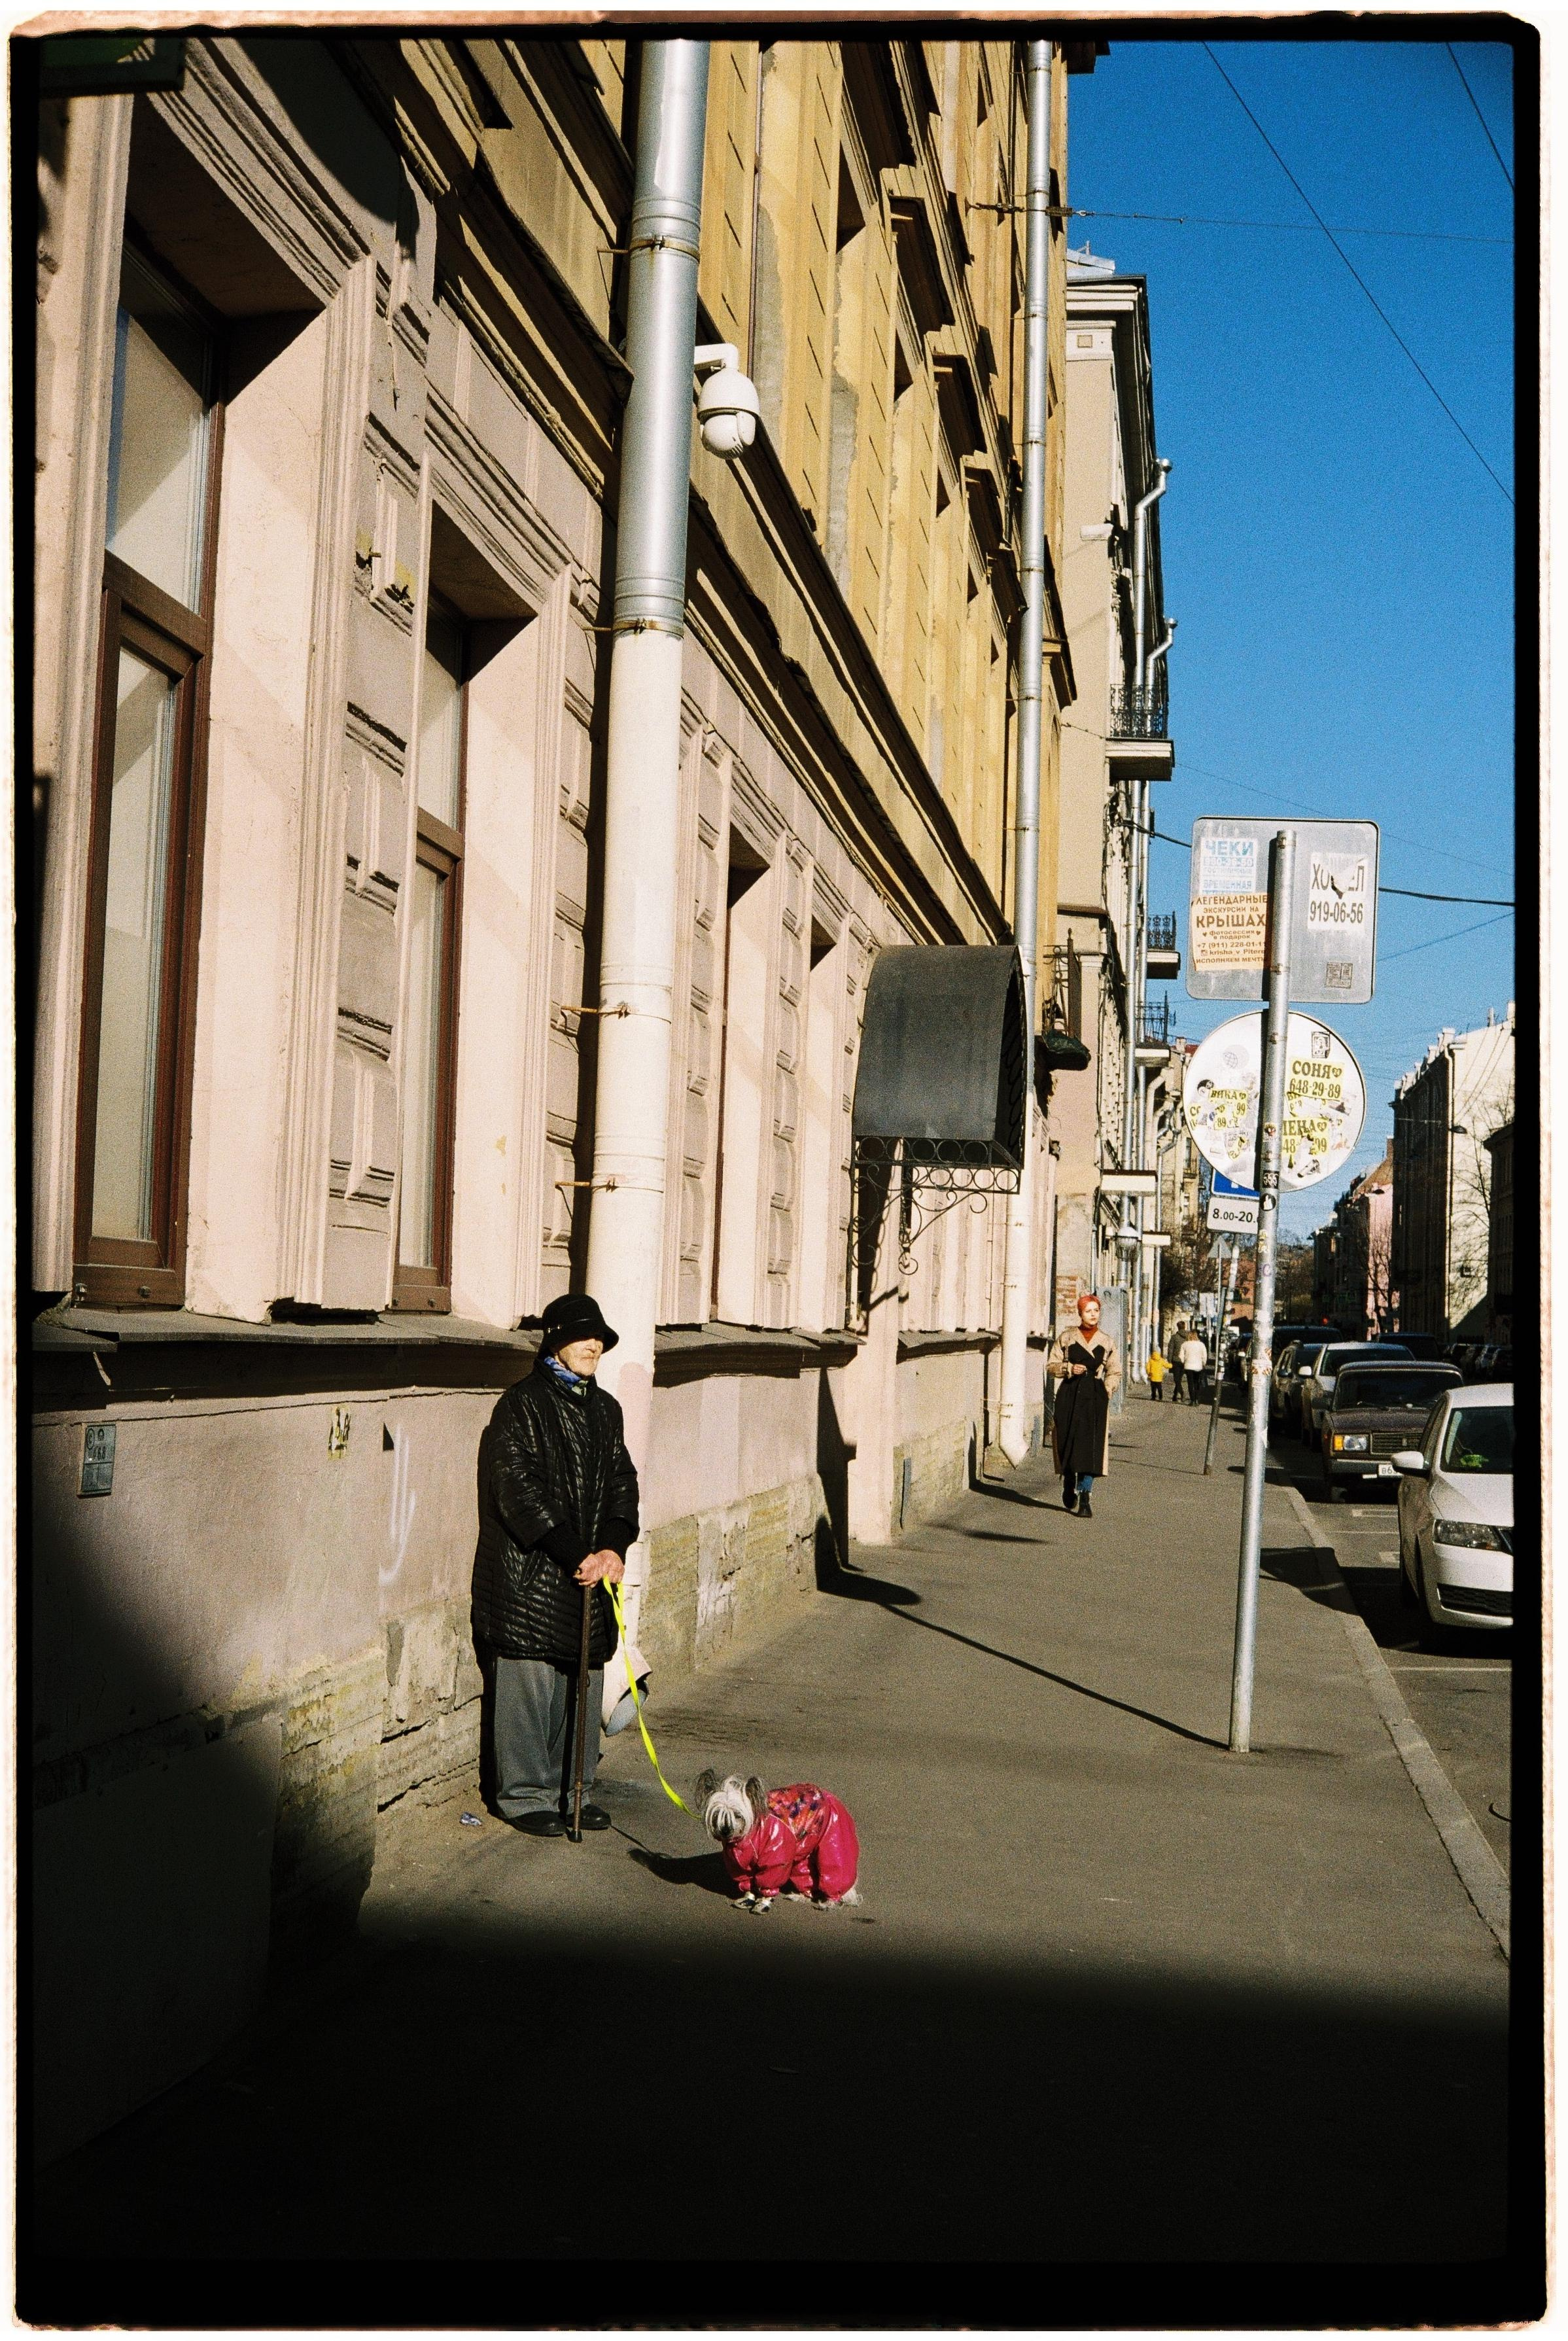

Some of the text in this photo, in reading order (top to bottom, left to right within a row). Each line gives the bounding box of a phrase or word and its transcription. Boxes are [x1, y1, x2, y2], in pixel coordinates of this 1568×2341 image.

[1205, 840, 1253, 856] ЧЕКИ
[1196, 895, 1267, 905] ЛЕГЕНДАРНЫЕ
[1310, 900, 1363, 924] 919-06-56
[1196, 914, 1266, 928] КРЫШАХ
[1292, 1060, 1332, 1079] СОНЯ
[1289, 1078, 1341, 1099] 648-29-89
[1212, 1208, 1256, 1223] 8.00-20.
